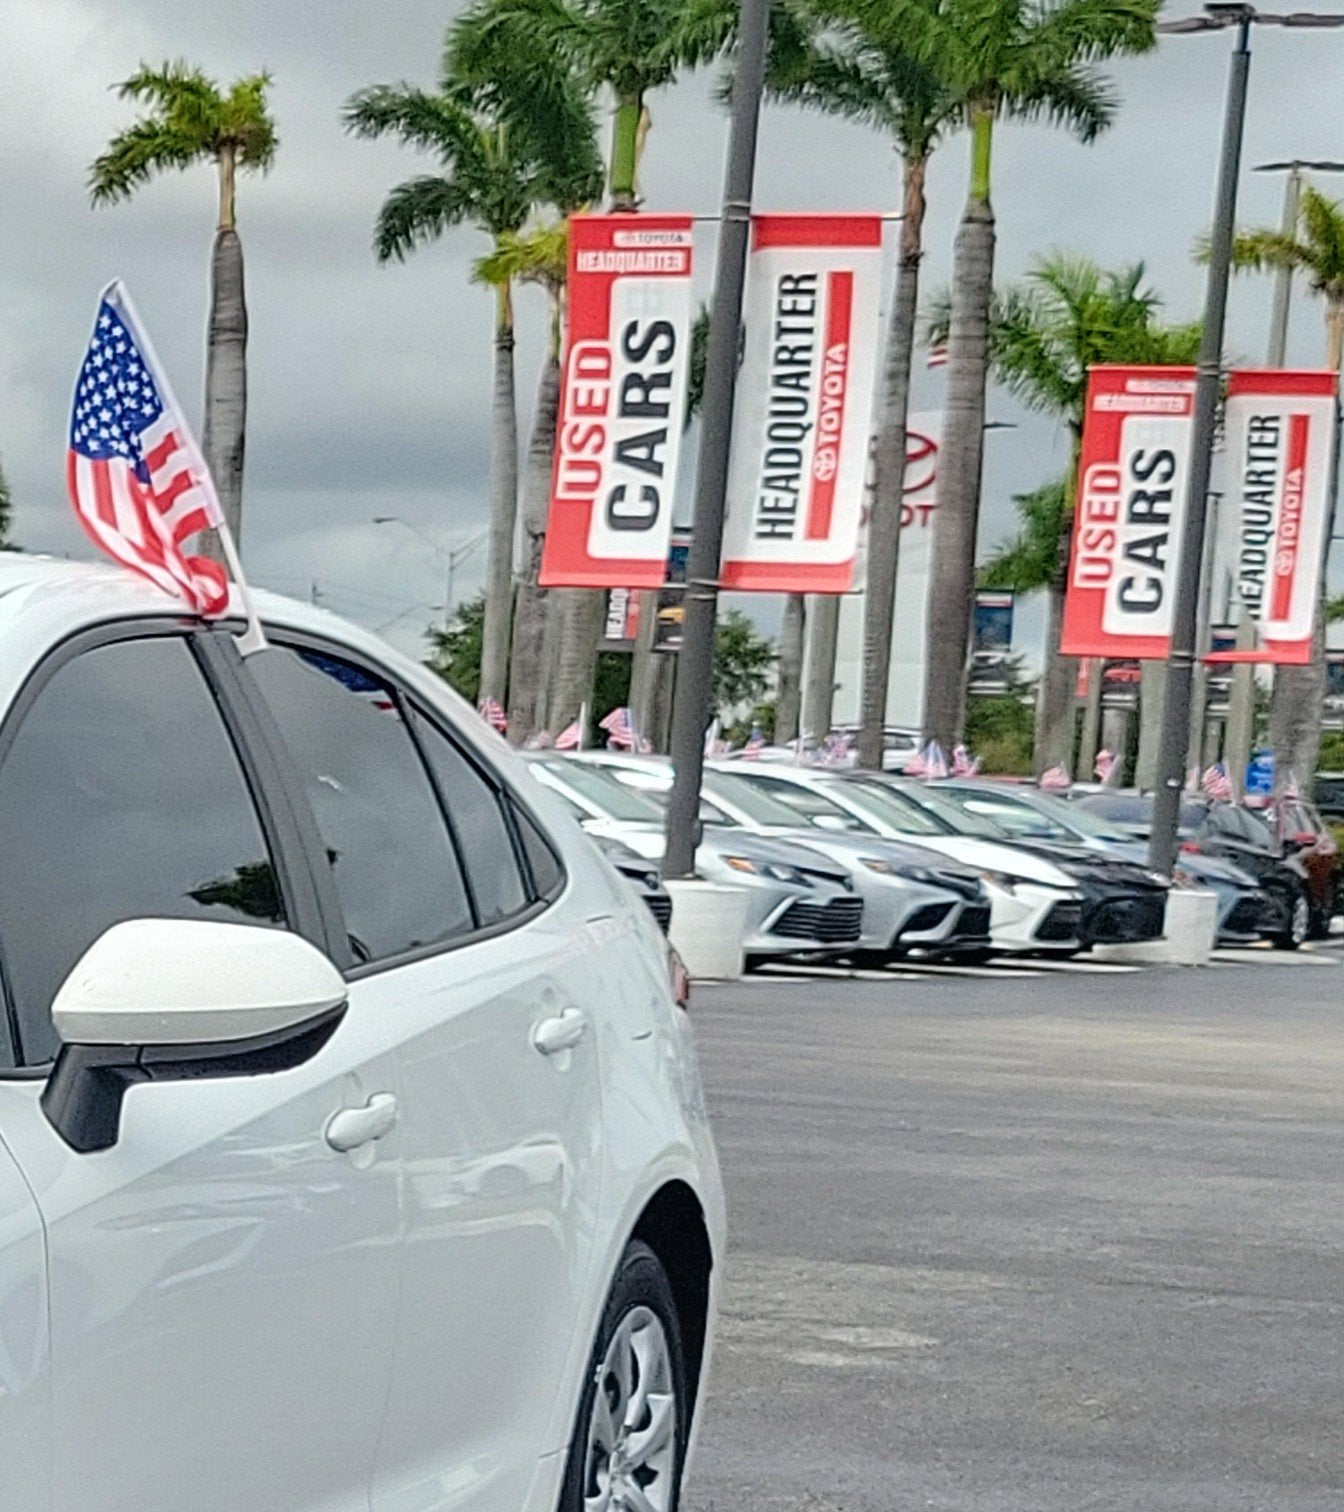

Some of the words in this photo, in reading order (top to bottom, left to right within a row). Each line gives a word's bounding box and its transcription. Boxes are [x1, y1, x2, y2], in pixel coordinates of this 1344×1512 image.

[562, 346, 612, 494] USED
[605, 319, 677, 532] CARS
[755, 273, 818, 541] HEADQUARTER
[818, 342, 847, 448] TOYOTA
[1079, 471, 1120, 584] USED
[1117, 448, 1177, 615] CARS
[1238, 415, 1281, 621] HEADQUARTER
[1278, 467, 1303, 550] TOYOTA
